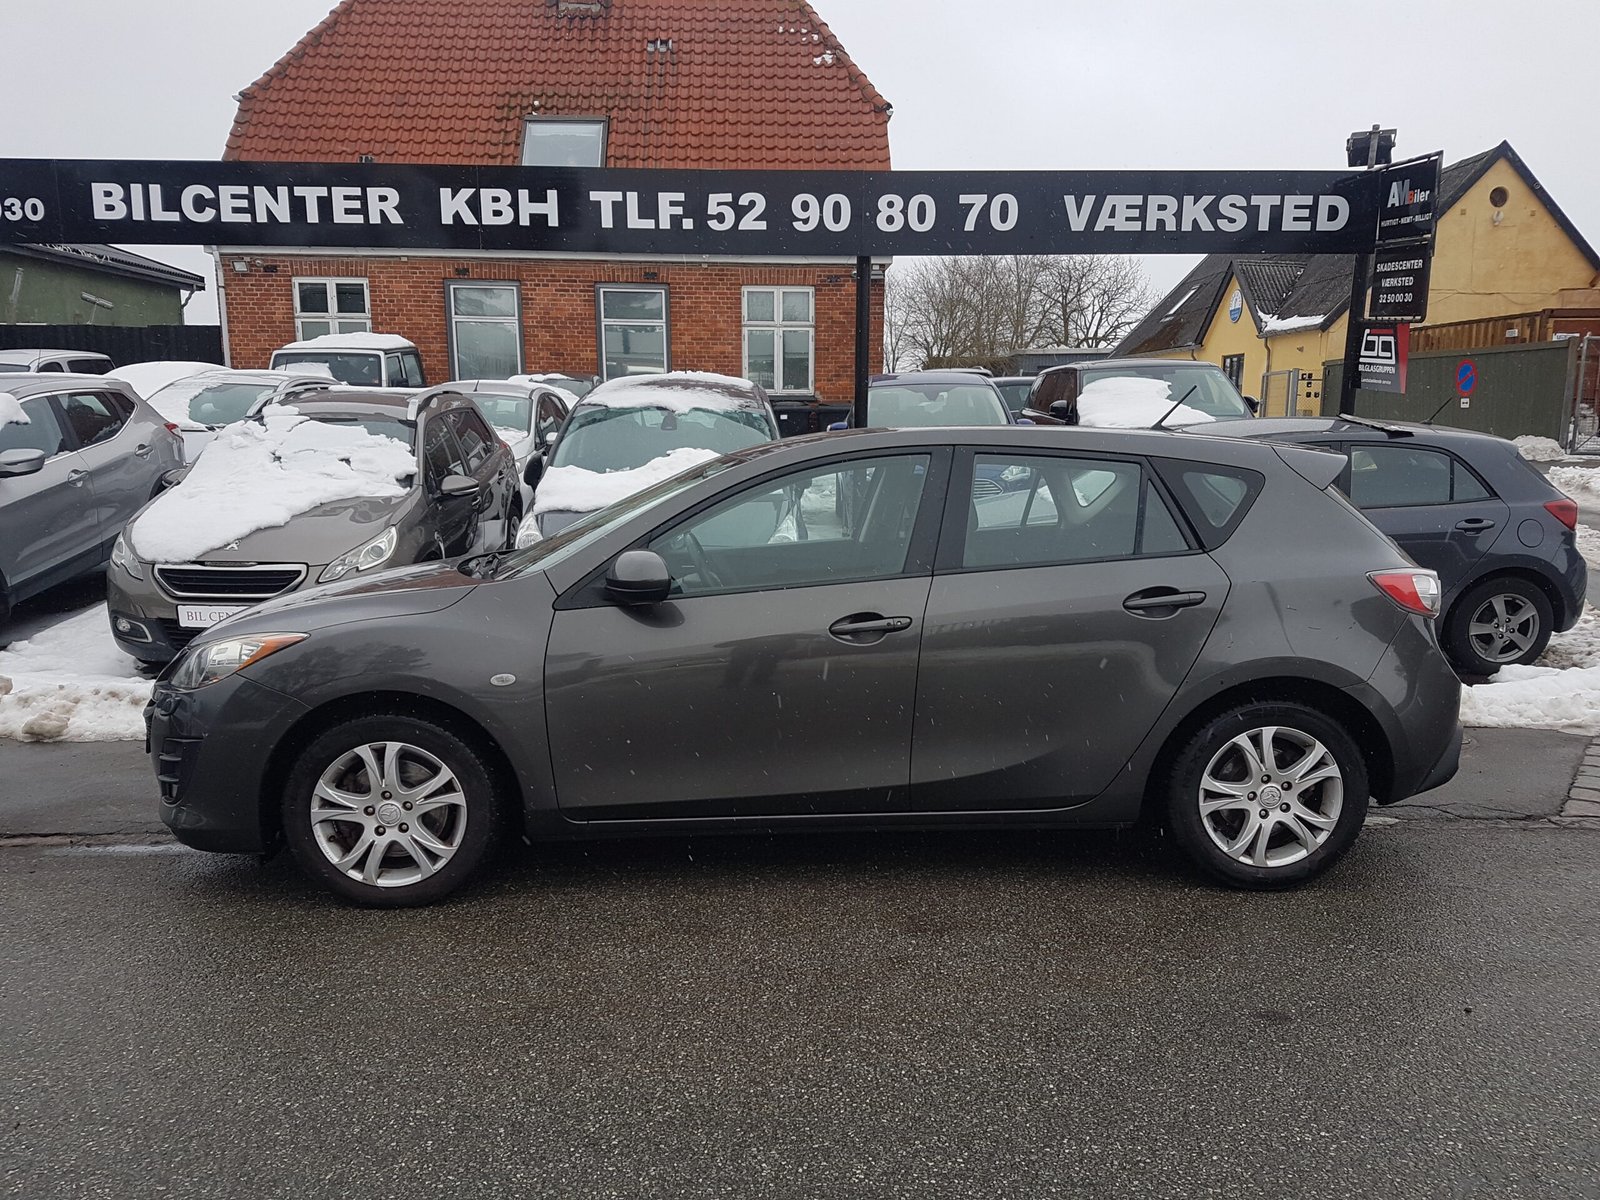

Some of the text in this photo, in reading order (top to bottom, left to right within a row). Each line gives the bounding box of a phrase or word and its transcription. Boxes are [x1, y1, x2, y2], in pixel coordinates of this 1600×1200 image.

[0, 197, 45, 221] 30
[91, 182, 1350, 232] BILCENTER KBH TLF. 52 90 80 70 VÆRKSTED
[1376, 259, 1423, 272] SKADESCENTER
[1381, 276, 1414, 288] VÆRKSTED
[1358, 364, 1396, 374] BILGLASGRUPPEN
[186, 611, 207, 621] BIL
